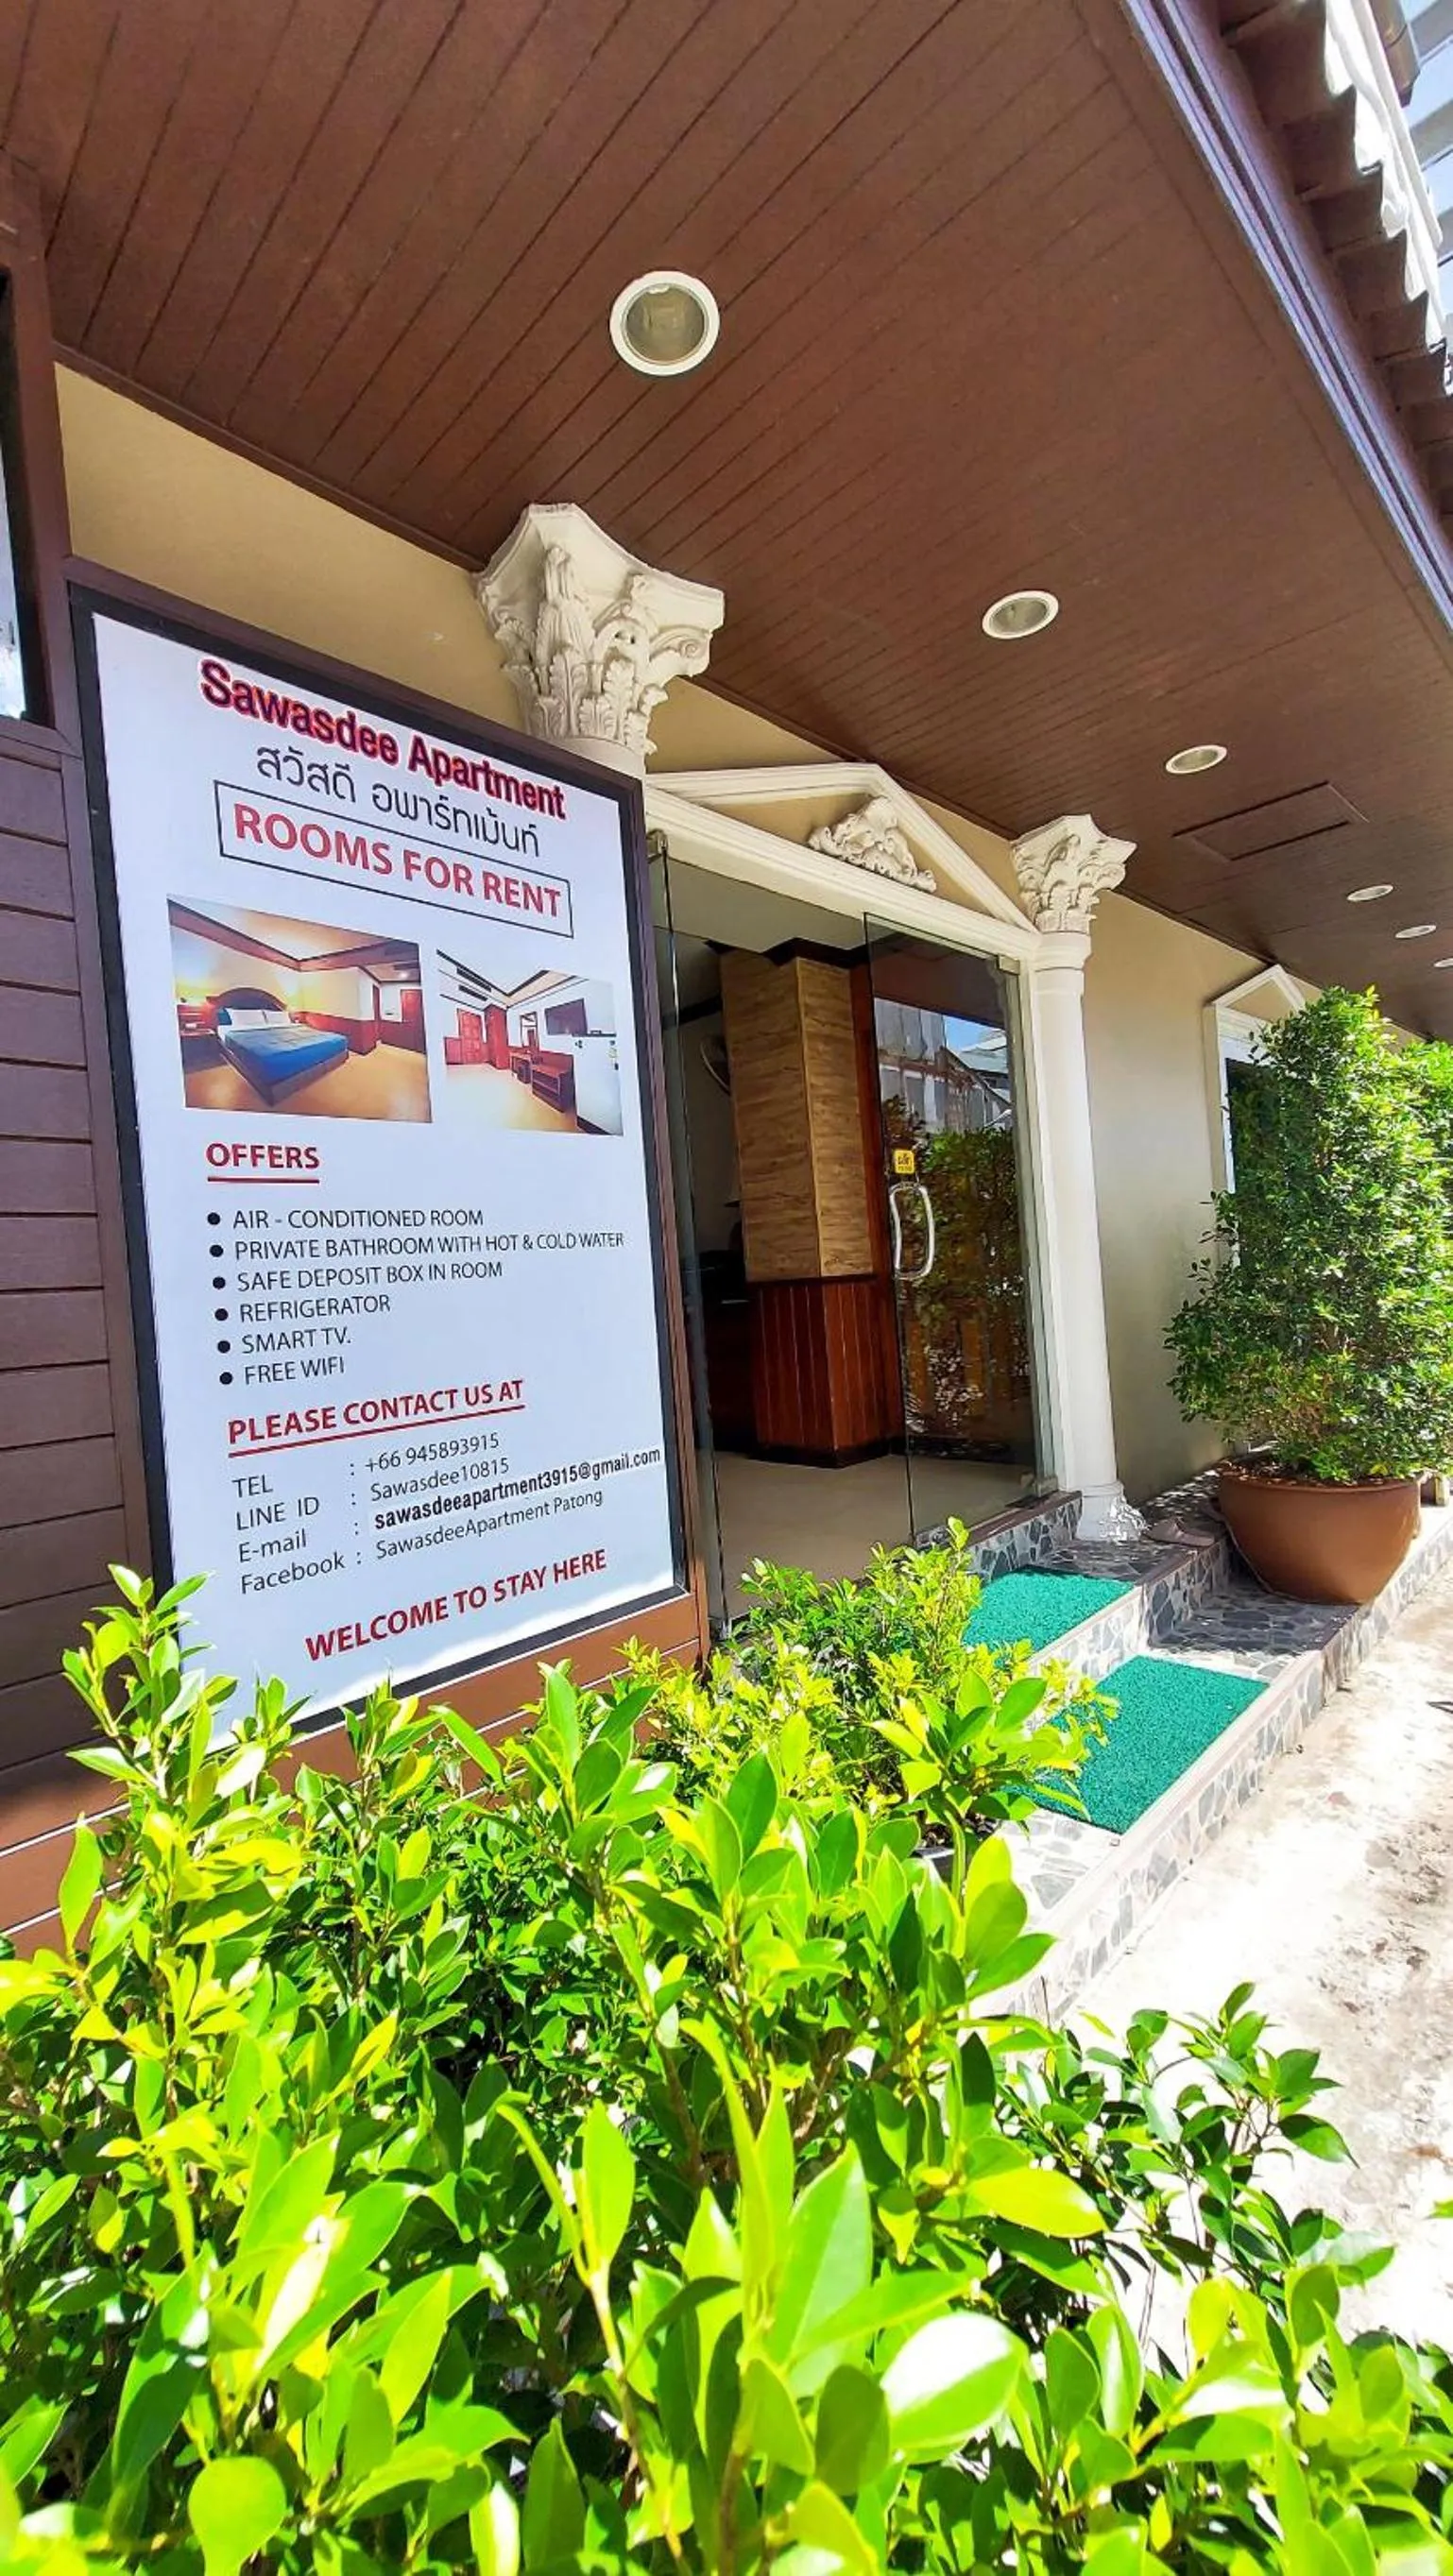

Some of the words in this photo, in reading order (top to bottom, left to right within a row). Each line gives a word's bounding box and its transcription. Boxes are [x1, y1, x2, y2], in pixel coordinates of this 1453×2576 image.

[200, 658, 400, 766] Sawasdee
[407, 734, 567, 821] Apartment
[257, 745, 355, 803] สวัสดี
[233, 803, 393, 875] ROOMS
[403, 849, 474, 896] FOR
[482, 870, 560, 918] RENT
[205, 1142, 320, 1169] OFFERS
[232, 1210, 269, 1228] AIR
[287, 1210, 425, 1228] CONDITIONED
[430, 1209, 484, 1226] ROOM
[235, 1239, 320, 1260] PRIVATE
[326, 1237, 434, 1257] BATHROOM
[437, 1236, 481, 1254] WITH
[486, 1235, 519, 1252] HOT
[522, 1234, 534, 1251] &
[537, 1233, 576, 1249] COLD
[579, 1232, 624, 1248] WATER
[237, 1271, 291, 1291] SAFE
[298, 1267, 382, 1288] DEPOSIT
[386, 1265, 424, 1283] BOX
[428, 1264, 446, 1281] IN
[451, 1261, 504, 1279] ROOM
[239, 1294, 391, 1323] REFRIGERATOR
[241, 1328, 317, 1355] SMART
[321, 1326, 351, 1346] TV.
[244, 1361, 297, 1386] FREE
[300, 1356, 345, 1378] WIFI
[228, 1406, 338, 1445] PLEASE
[343, 1389, 458, 1425] CONTACT
[464, 1383, 494, 1407] US
[499, 1379, 523, 1402] AT
[231, 1474, 274, 1498] TEL
[365, 1450, 402, 1474] +66
[405, 1431, 500, 1466] 945893915
[236, 1501, 287, 1531] LINE
[297, 1496, 320, 1517] ID
[370, 1457, 510, 1502] Sawasdee10815
[238, 1527, 307, 1563] E-mail
[374, 1446, 661, 1530] sawasdeeapartment3915@gmail.com
[241, 1551, 346, 1595] Facebook
[376, 1500, 551, 1561] SawasdeeApartment
[553, 1489, 604, 1516] Patong
[305, 1595, 450, 1662] WELCOME
[453, 1585, 487, 1613] TO
[493, 1564, 547, 1603] STAY
[553, 1548, 607, 1583] HERE
